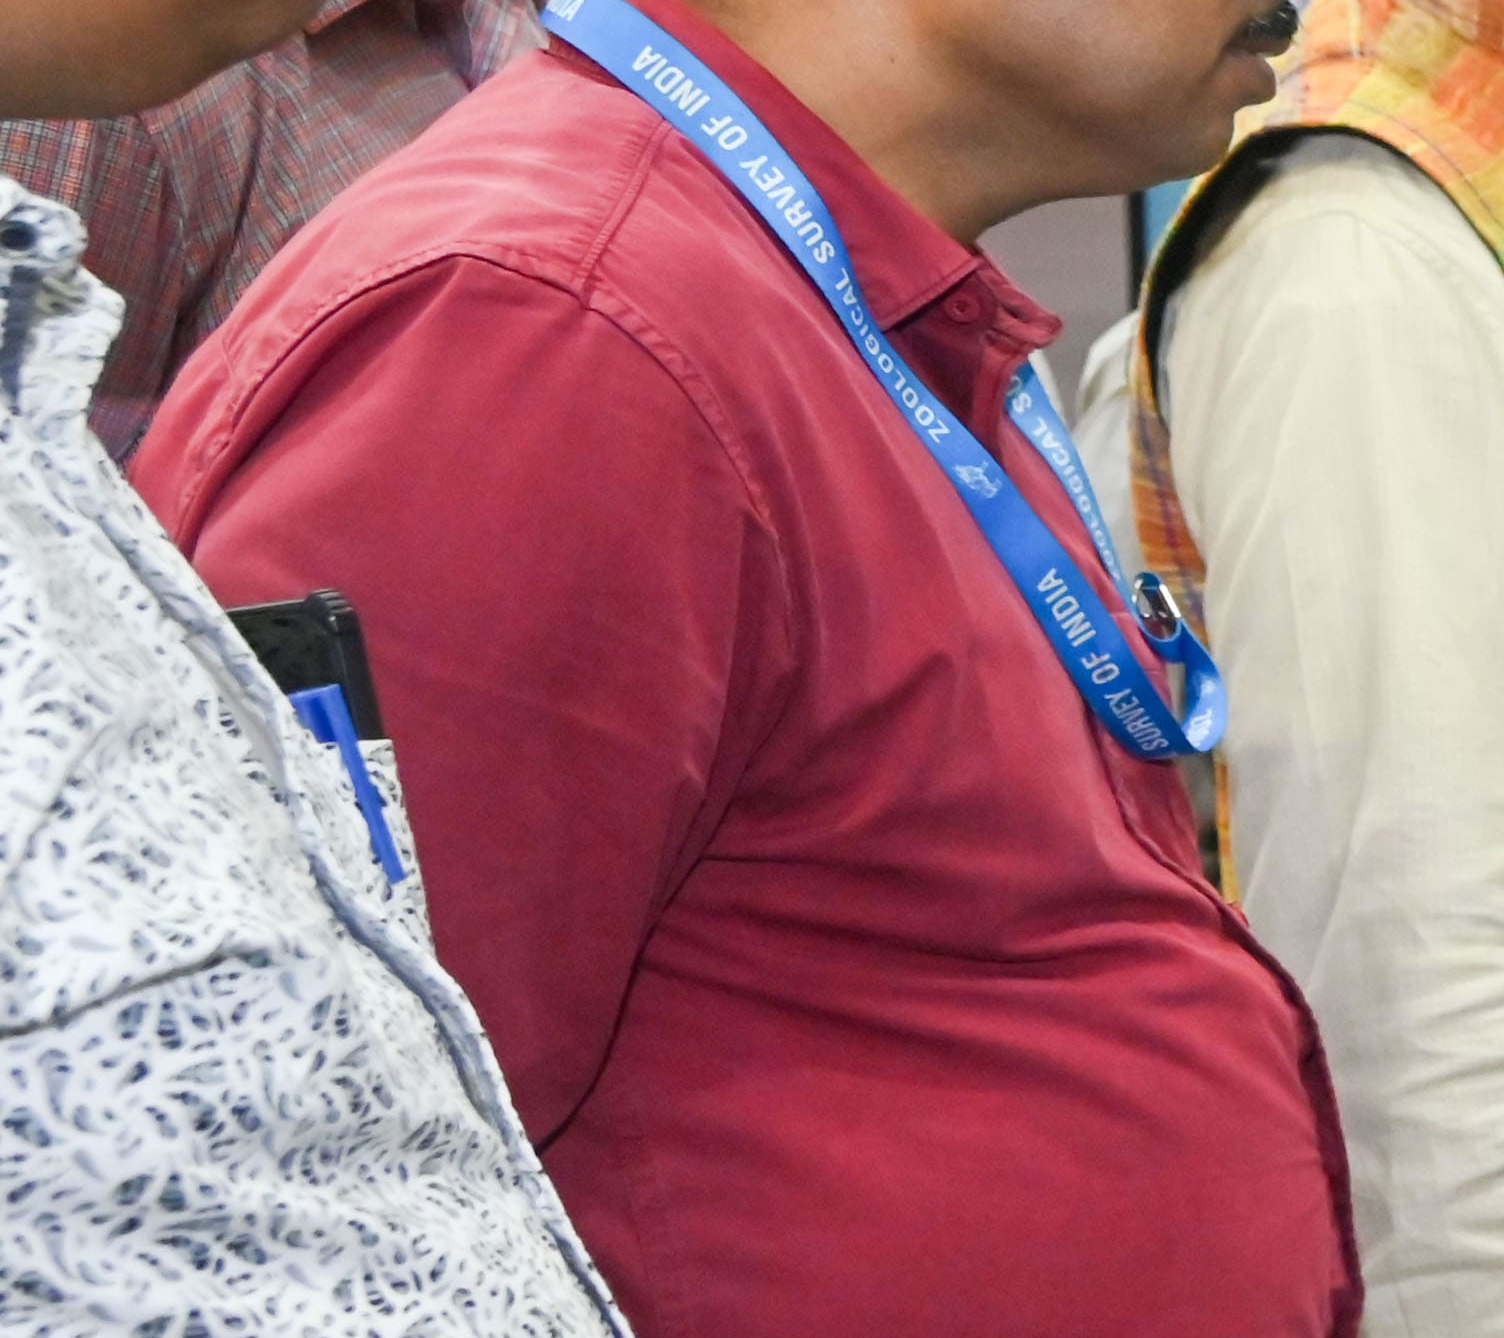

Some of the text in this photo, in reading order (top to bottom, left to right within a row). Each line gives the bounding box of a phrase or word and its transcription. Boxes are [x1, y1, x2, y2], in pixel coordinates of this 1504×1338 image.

[632, 45, 951, 444] ZOOLOGICAL SURVEY OF INDIA
[1037, 568, 1169, 751] SURVEY OF INDIA
